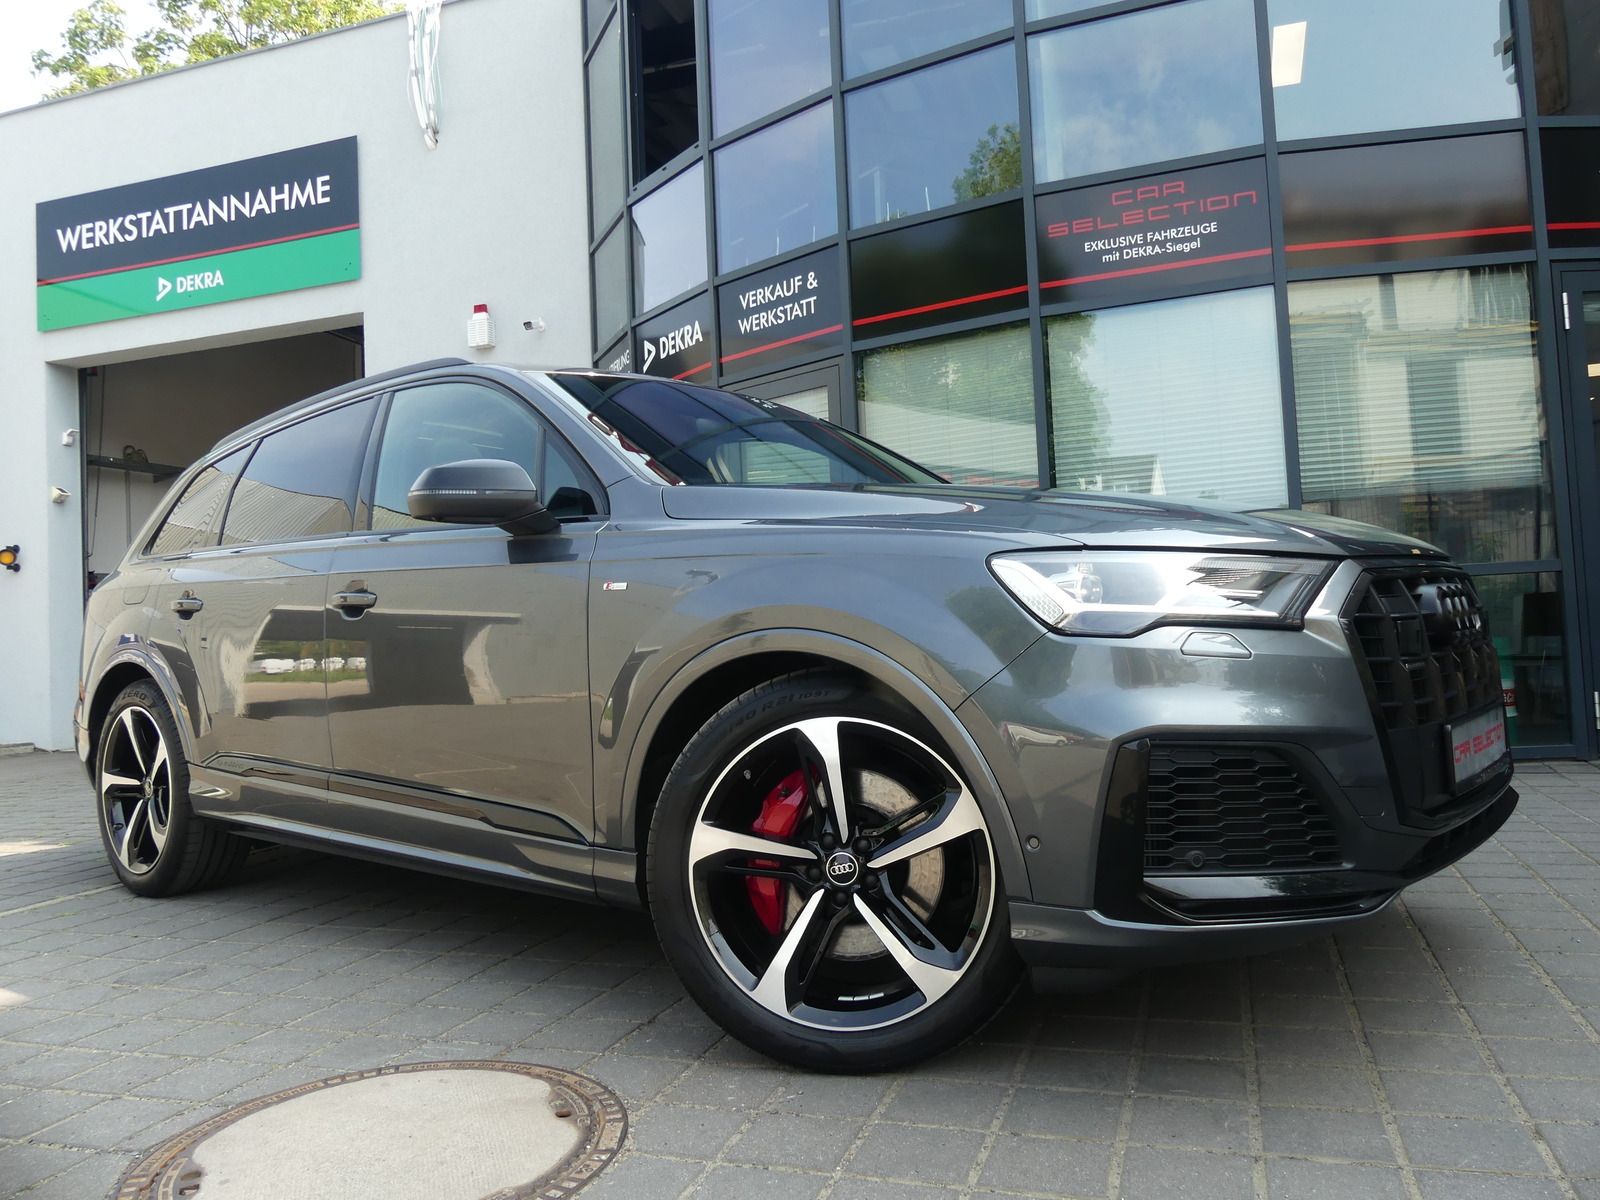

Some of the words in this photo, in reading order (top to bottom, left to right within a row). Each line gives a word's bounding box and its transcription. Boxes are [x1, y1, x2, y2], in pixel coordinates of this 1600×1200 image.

[1111, 180, 1185, 206] CAR
[56, 174, 331, 253] WERKSTATTANNAHME
[1047, 190, 1257, 239] SELECTION
[1084, 233, 1144, 253] EXKLUSIVE
[1147, 222, 1218, 244] FAHRZEUGE
[1102, 252, 1120, 263] mit
[1123, 238, 1201, 260] DEKRA-Siegel
[176, 269, 225, 294] DEKRA
[739, 275, 803, 311] VERKAUF
[807, 271, 819, 289] &
[738, 296, 818, 335] WERKSTATT
[659, 320, 704, 360] DEKRA
